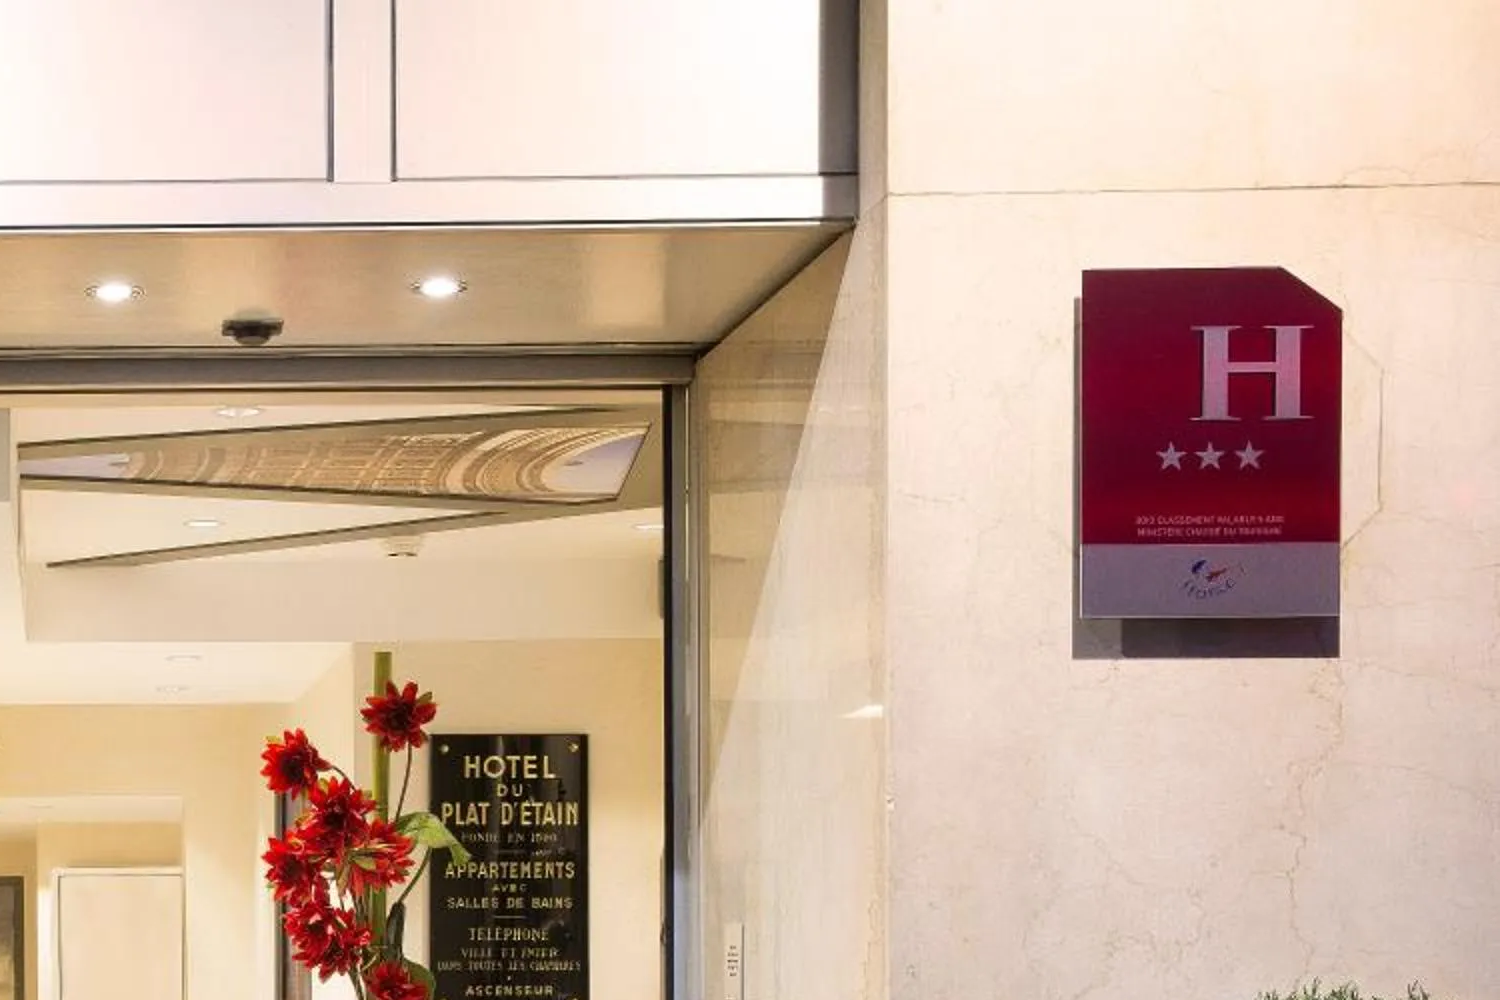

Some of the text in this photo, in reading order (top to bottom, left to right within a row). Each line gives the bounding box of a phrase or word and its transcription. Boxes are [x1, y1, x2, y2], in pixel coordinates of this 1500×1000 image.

[1189, 325, 1315, 420] H
[463, 755, 556, 779] HOTEL
[496, 783, 524, 797] DU
[441, 802, 491, 826] PLAT
[444, 861, 575, 879] APPARTEMENTS
[506, 897, 524, 909] DE
